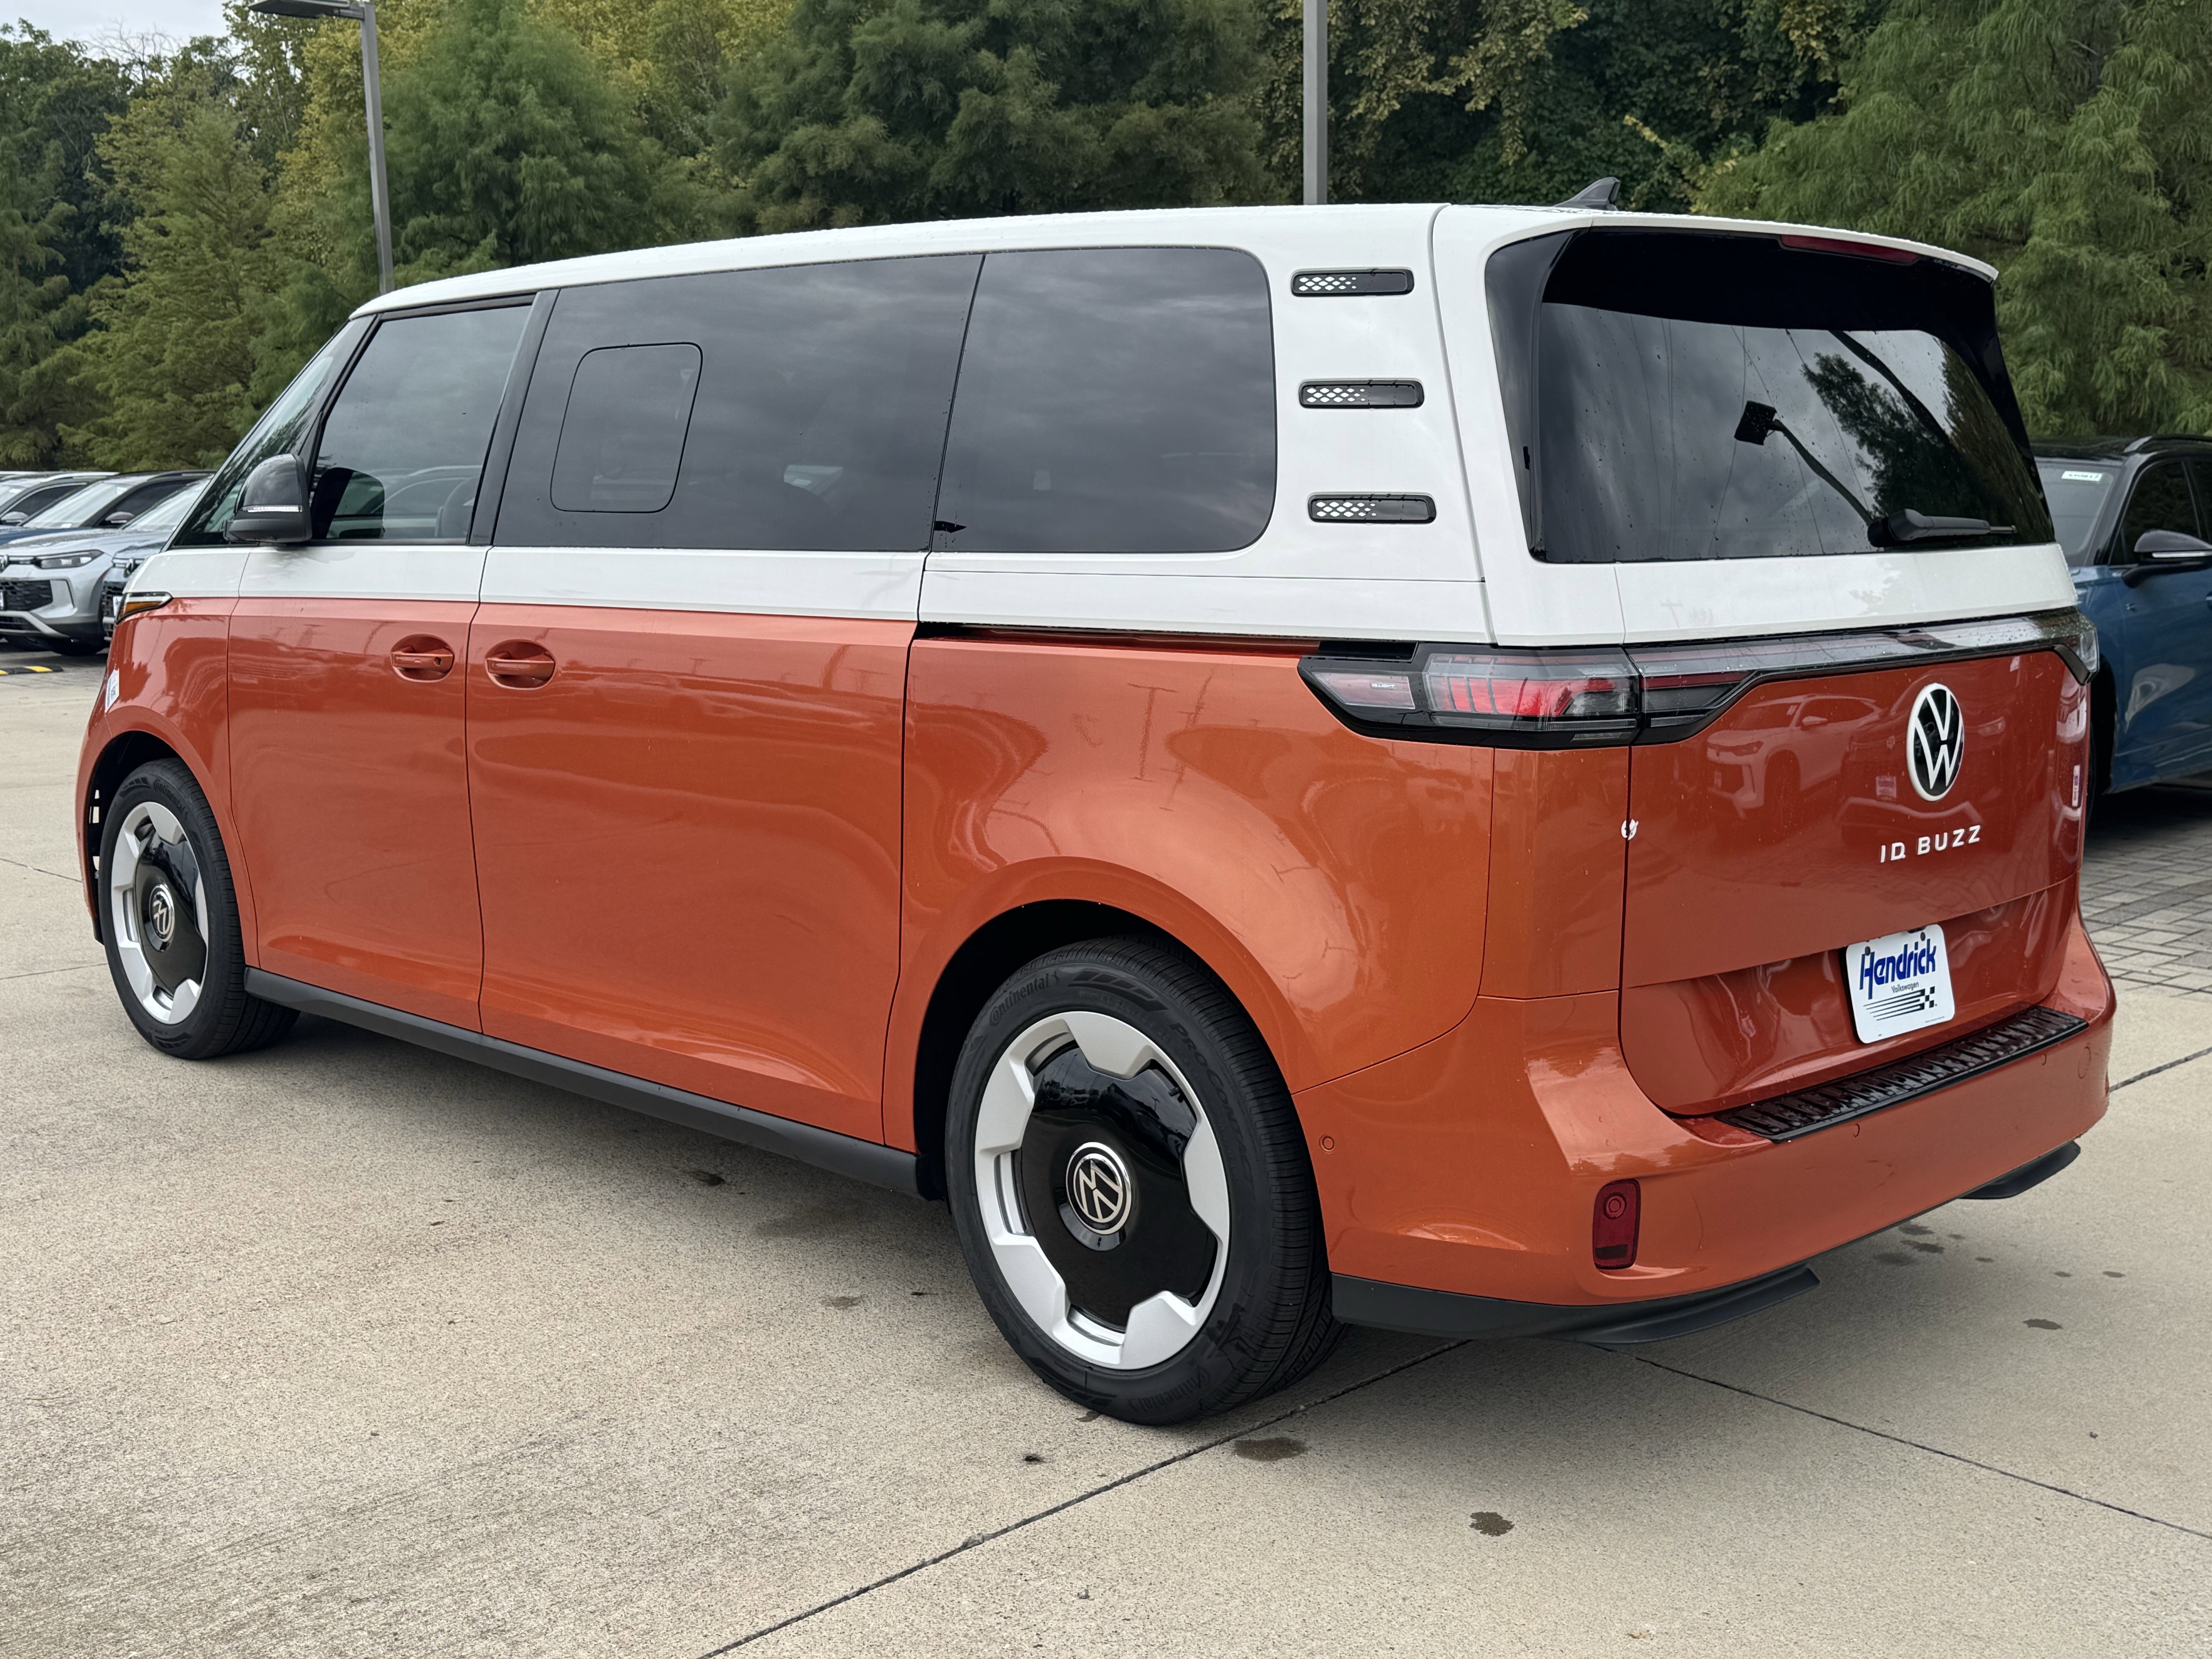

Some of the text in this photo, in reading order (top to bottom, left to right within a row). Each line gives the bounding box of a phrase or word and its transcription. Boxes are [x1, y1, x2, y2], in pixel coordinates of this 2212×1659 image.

[1917, 824, 1981, 855] BUZZ
[1859, 938, 1937, 1000] Hendrick
[1891, 982, 1919, 993] Volkswagen
[989, 973, 1049, 1026] Continental
